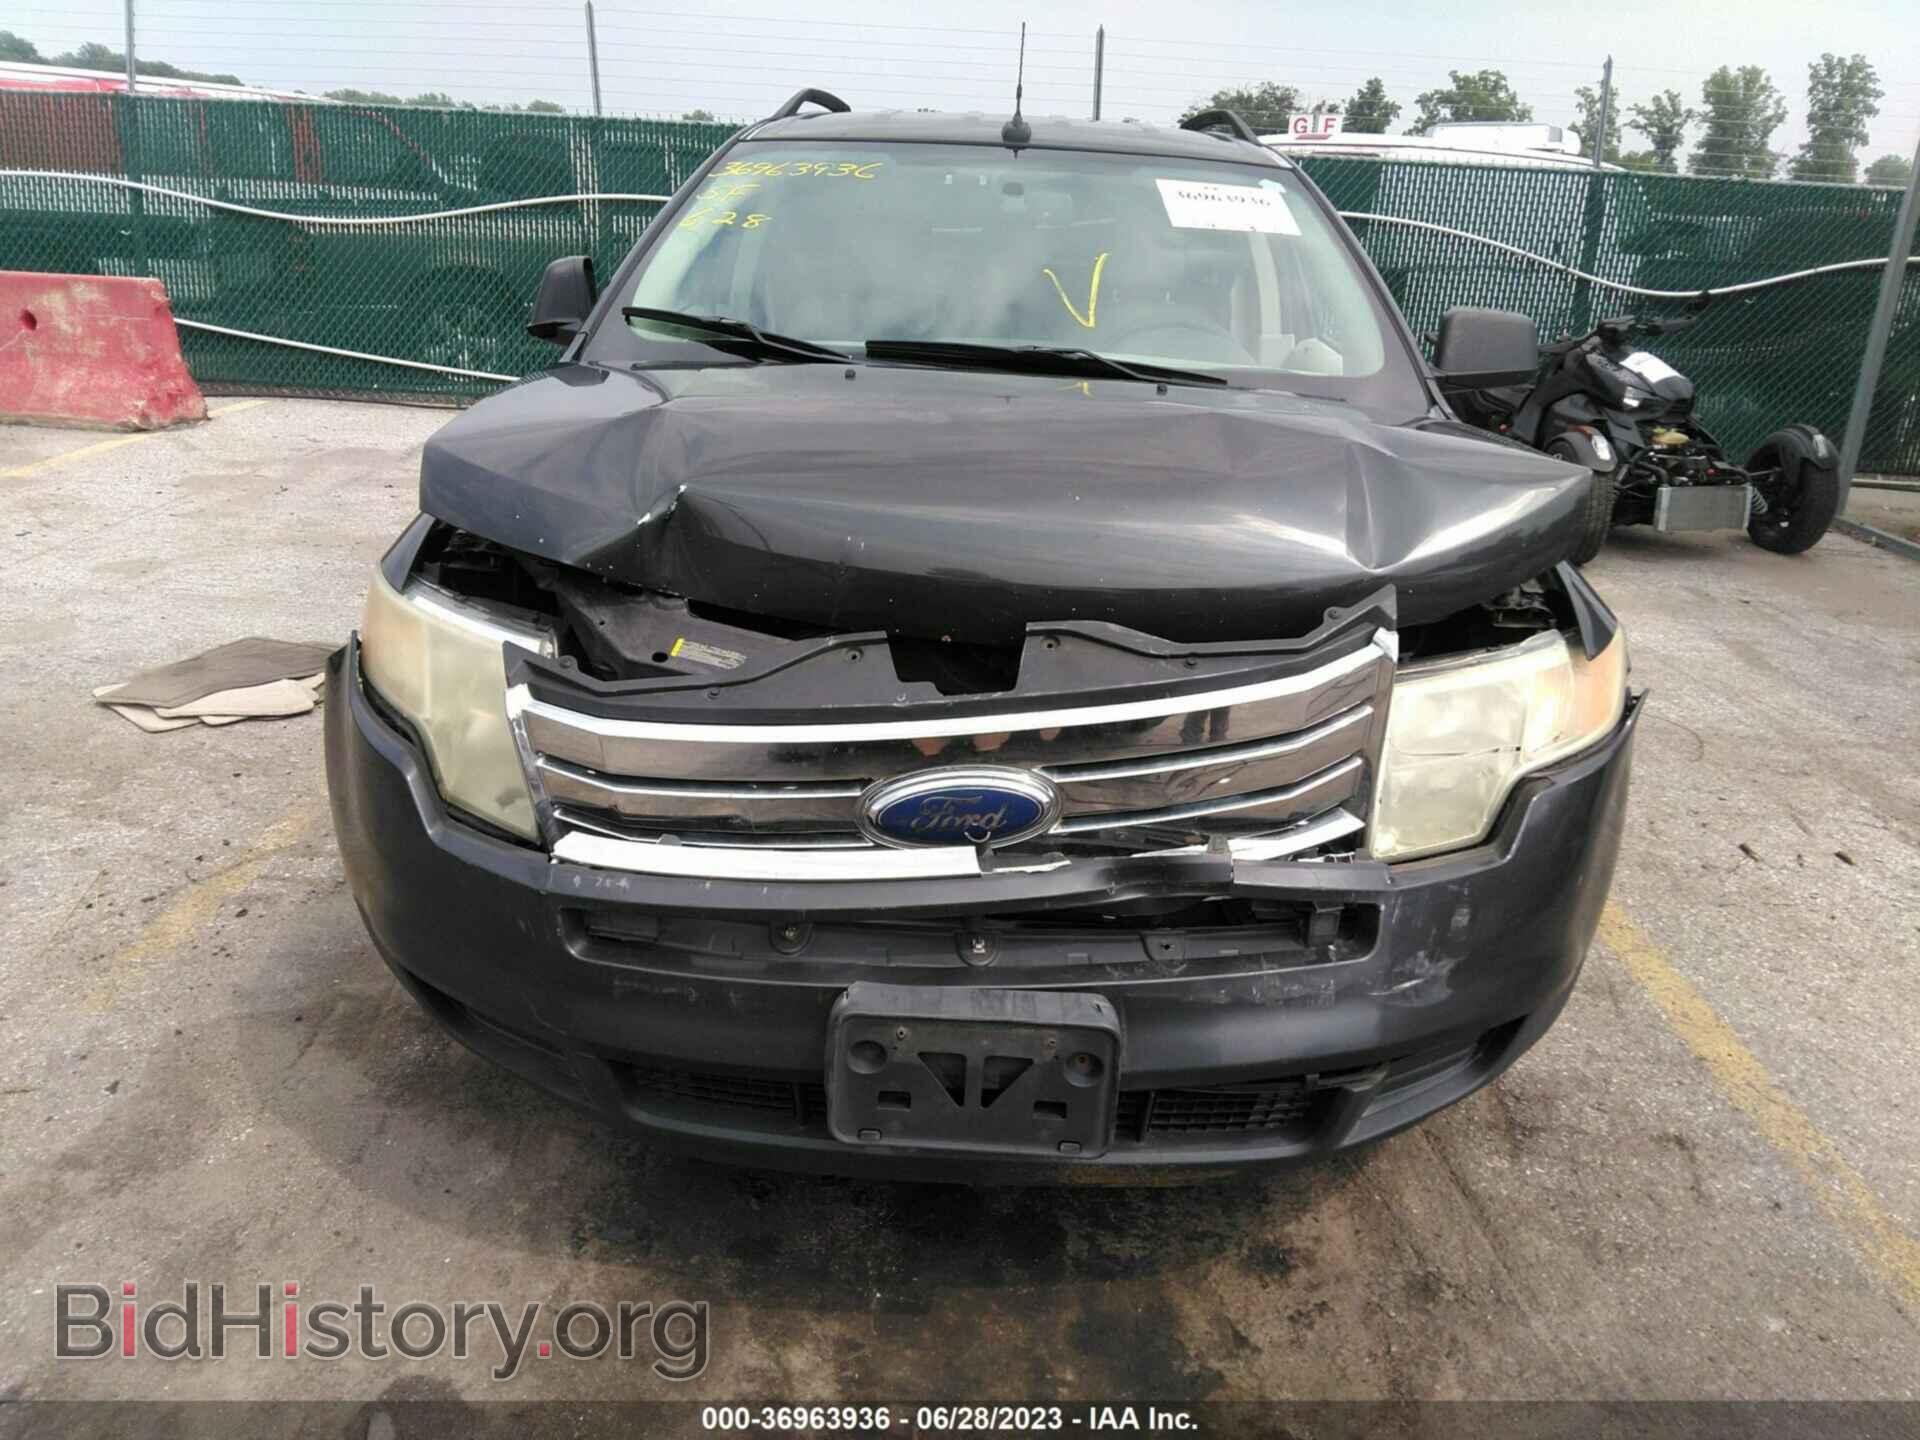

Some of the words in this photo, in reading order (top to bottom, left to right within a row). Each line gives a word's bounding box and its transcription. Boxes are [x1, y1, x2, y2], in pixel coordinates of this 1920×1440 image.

[1293, 117, 1308, 134] G
[1323, 117, 1337, 133] F
[910, 794, 1008, 832] Ford
